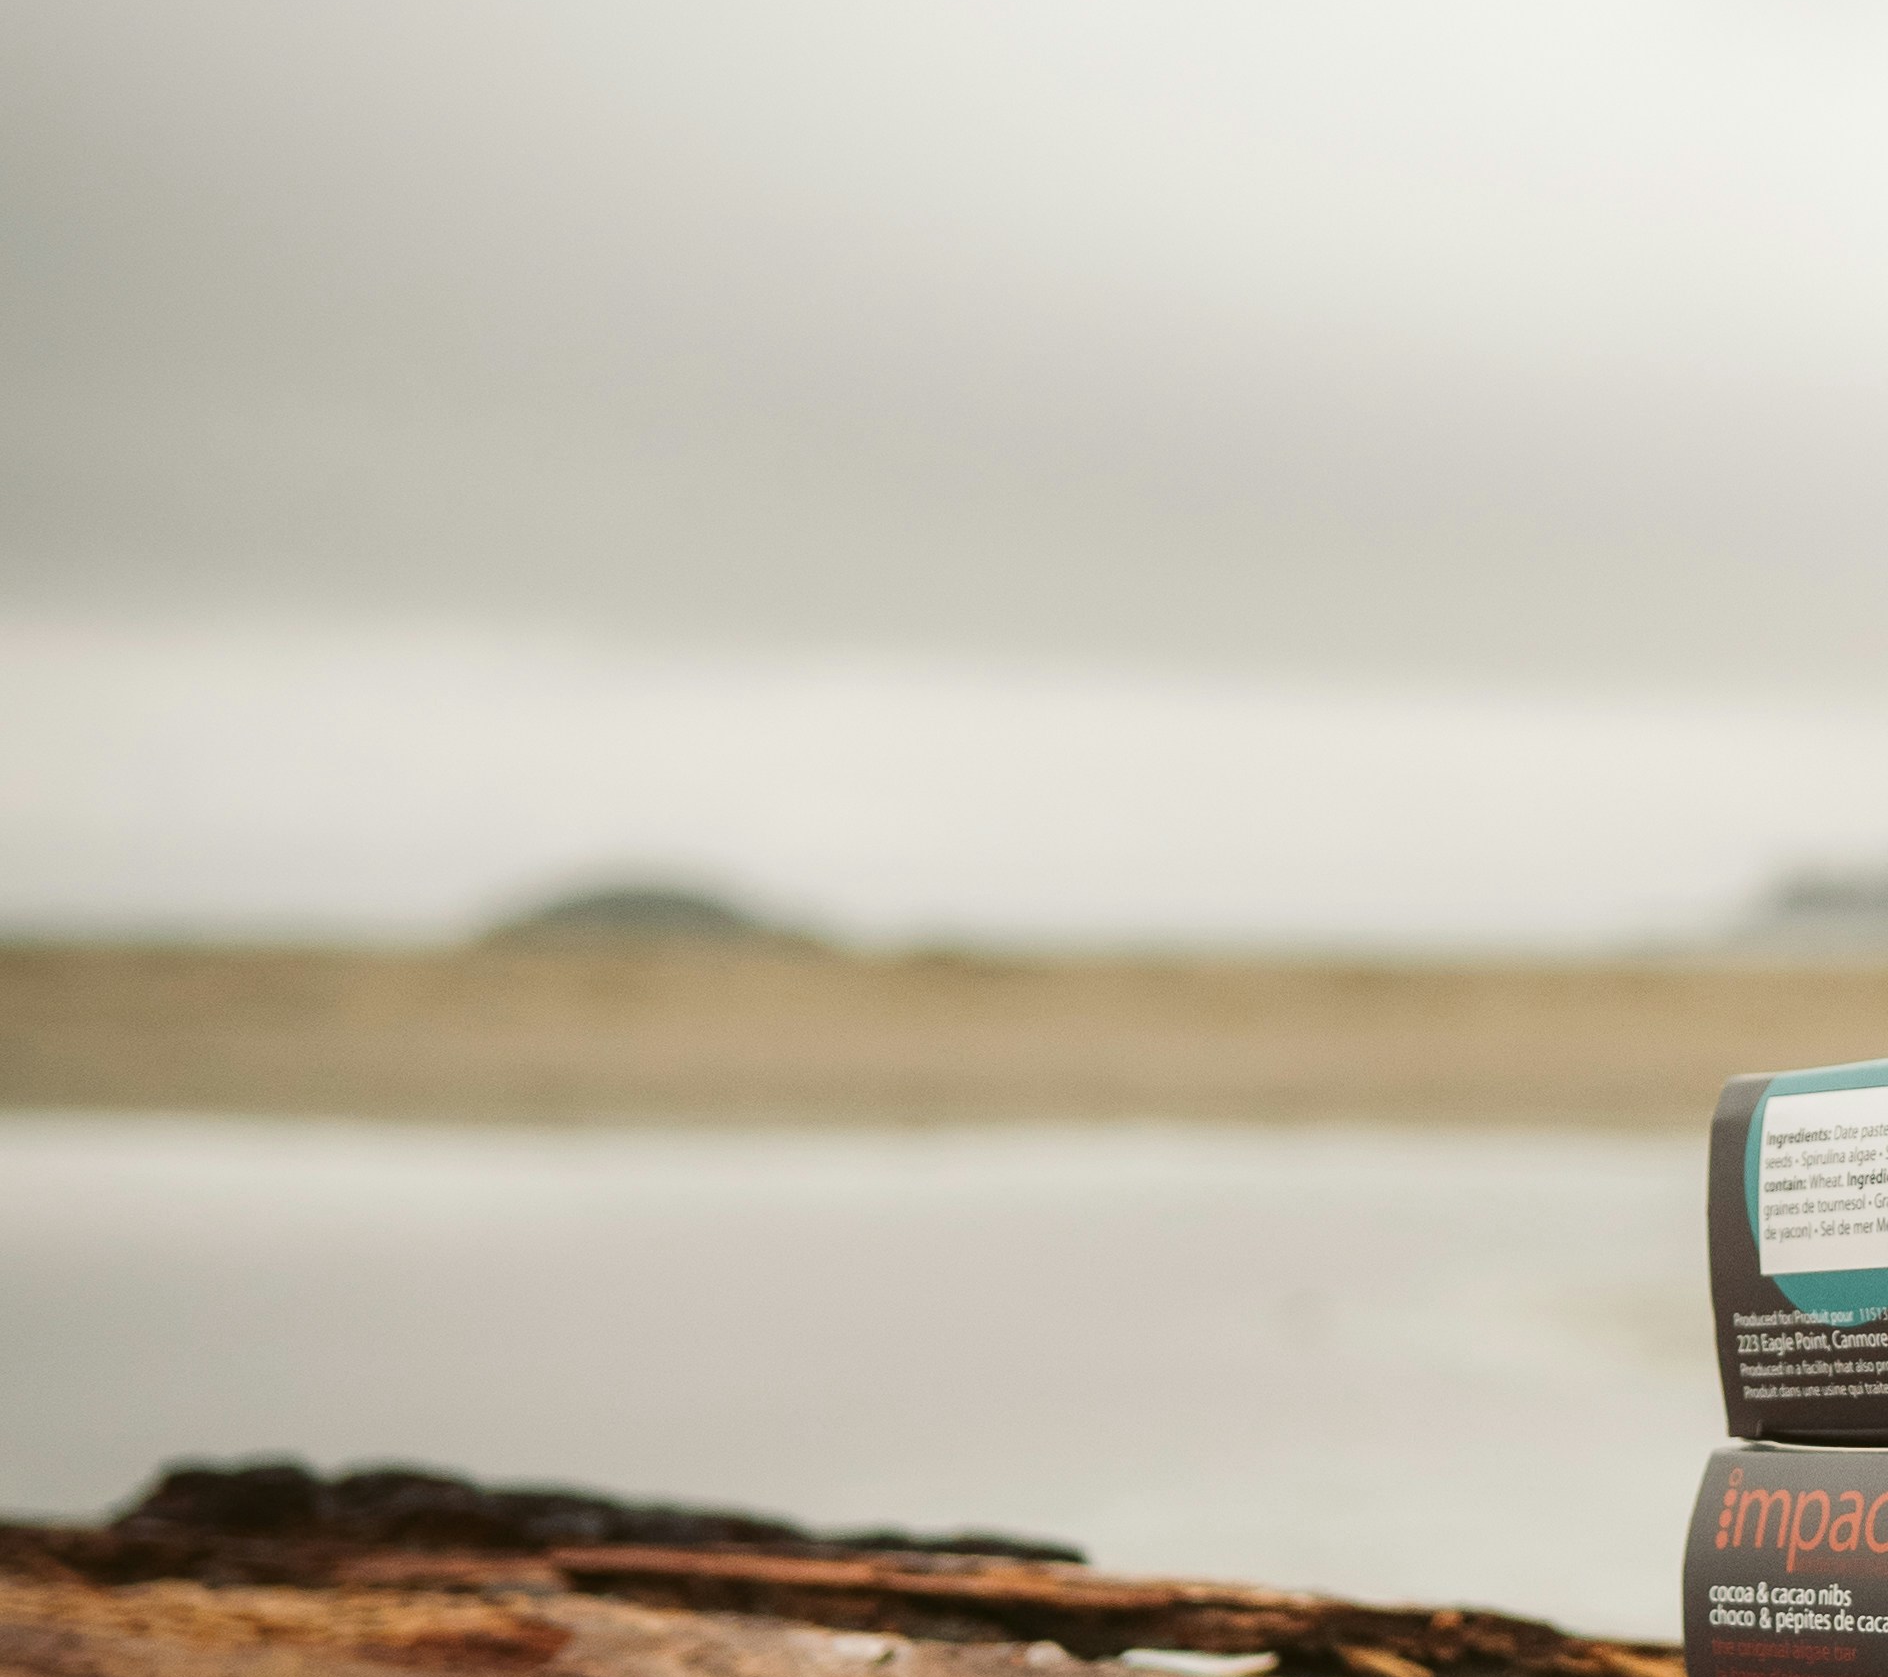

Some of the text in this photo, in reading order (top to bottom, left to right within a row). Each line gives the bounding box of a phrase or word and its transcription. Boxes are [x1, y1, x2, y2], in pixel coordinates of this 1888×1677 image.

[1766, 1127, 1832, 1148] Ingredients:
[1834, 1125, 1859, 1140] Date
[1860, 1123, 1888, 1139] paste
[1765, 1153, 1792, 1169] seeds
[1801, 1150, 1845, 1169] Spirulina
[1848, 1147, 1876, 1166] algae
[1764, 1176, 1806, 1193] contain:
[1764, 1200, 1799, 1221] graines
[1802, 1198, 1814, 1214] de
[1817, 1195, 1865, 1213] tournesol
[1764, 1225, 1776, 1240] de
[1820, 1220, 1835, 1237] Sel
[1838, 1219, 1851, 1235] de
[1853, 1220, 1874, 1234] mer
[1736, 1334, 1760, 1353] 223
[1760, 1332, 1794, 1356] Eagle
[1794, 1331, 1832, 1351] Point,
[1708, 1581, 1852, 1607] cocoa & cacao nibs
[1708, 1603, 1756, 1627] choco
[1759, 1606, 1772, 1629] &
[1775, 1607, 1831, 1634] pépites
[1834, 1608, 1854, 1631] de
